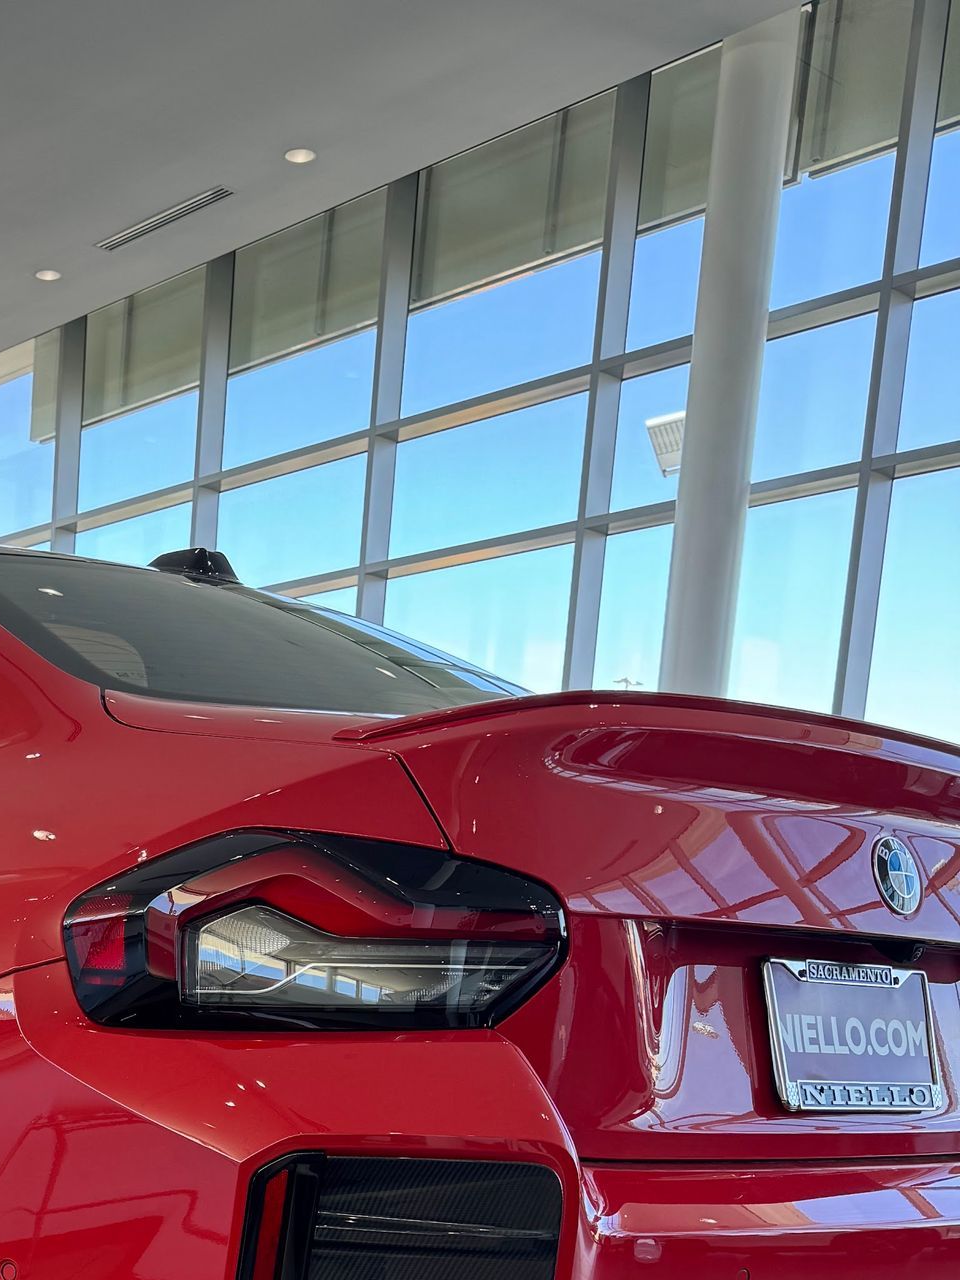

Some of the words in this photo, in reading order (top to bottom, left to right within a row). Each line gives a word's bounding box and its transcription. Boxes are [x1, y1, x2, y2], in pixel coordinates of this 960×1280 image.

[809, 963, 891, 983] SACRAMENTO
[779, 1013, 929, 1058] NIELLO.COM
[801, 1083, 932, 1107] NIELLO
